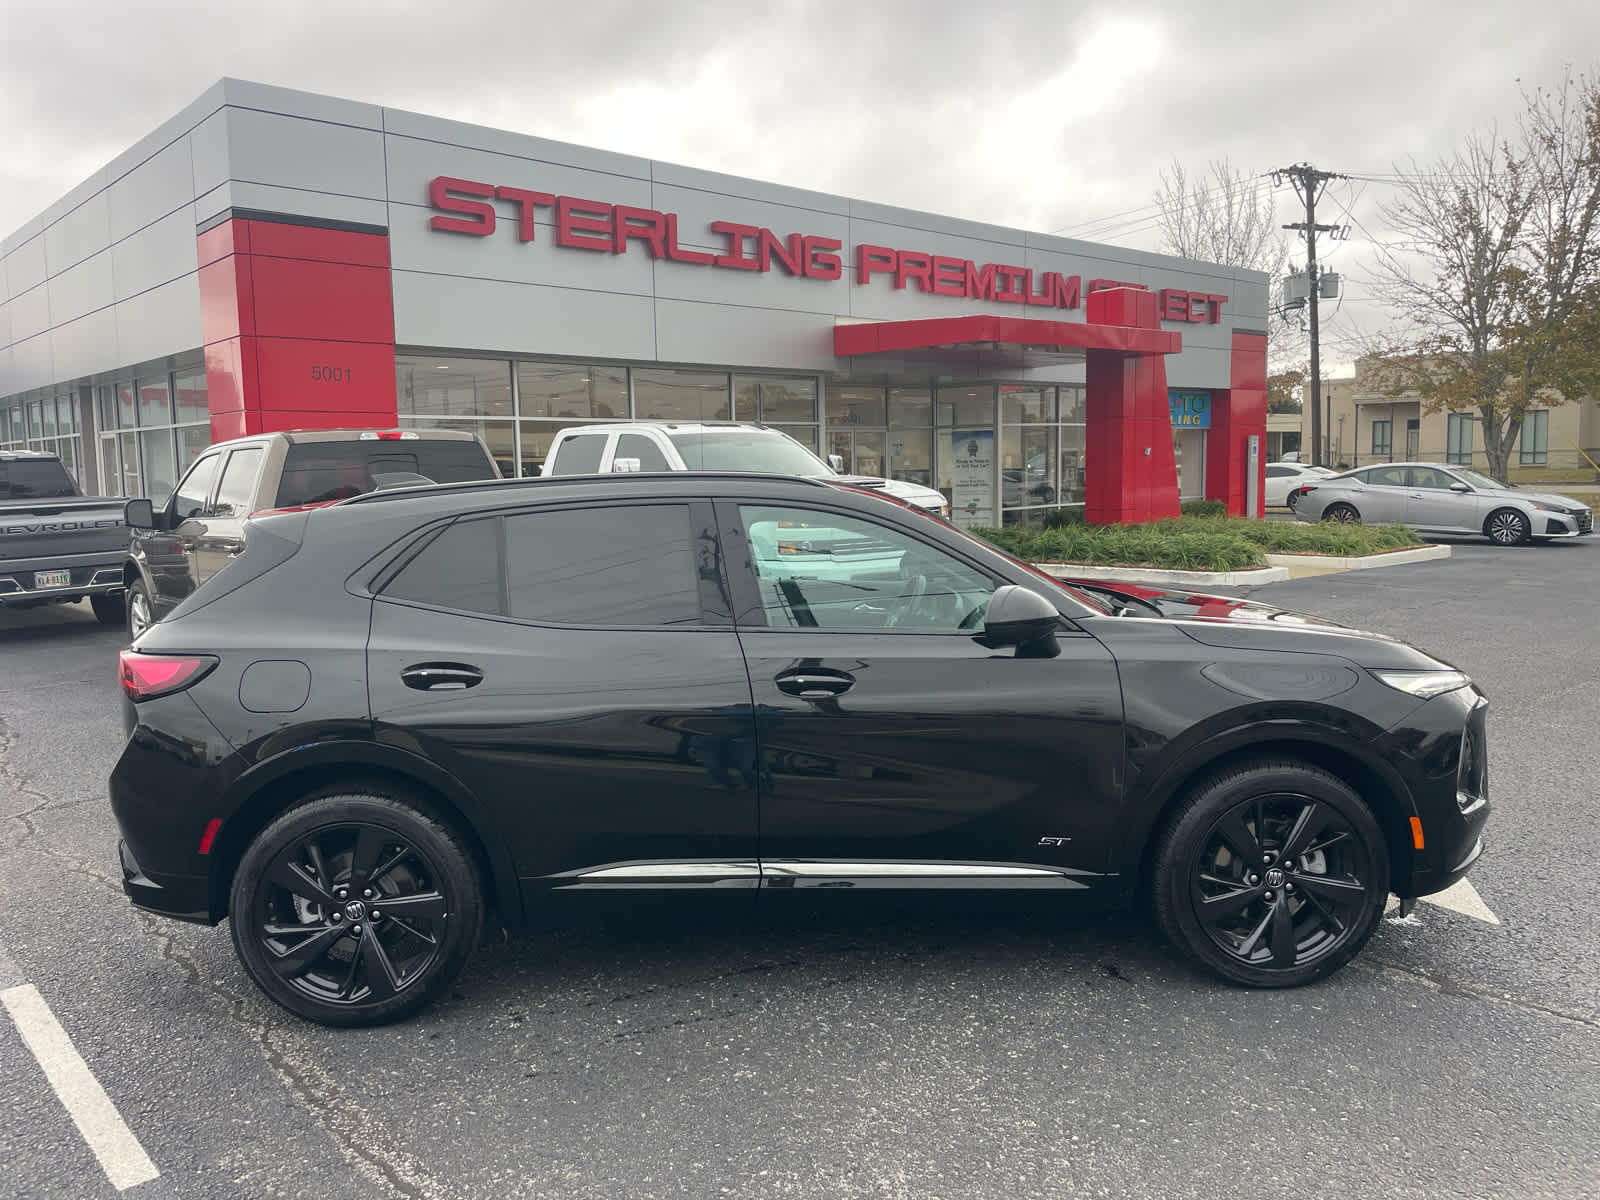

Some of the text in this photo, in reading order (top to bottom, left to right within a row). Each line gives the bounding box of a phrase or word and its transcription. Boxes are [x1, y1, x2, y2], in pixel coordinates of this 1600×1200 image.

[429, 176, 1229, 325] STERLING PREMIUM ECT
[311, 365, 352, 382] 5001
[1169, 394, 1208, 412] TO
[1037, 836, 1072, 846] ST
